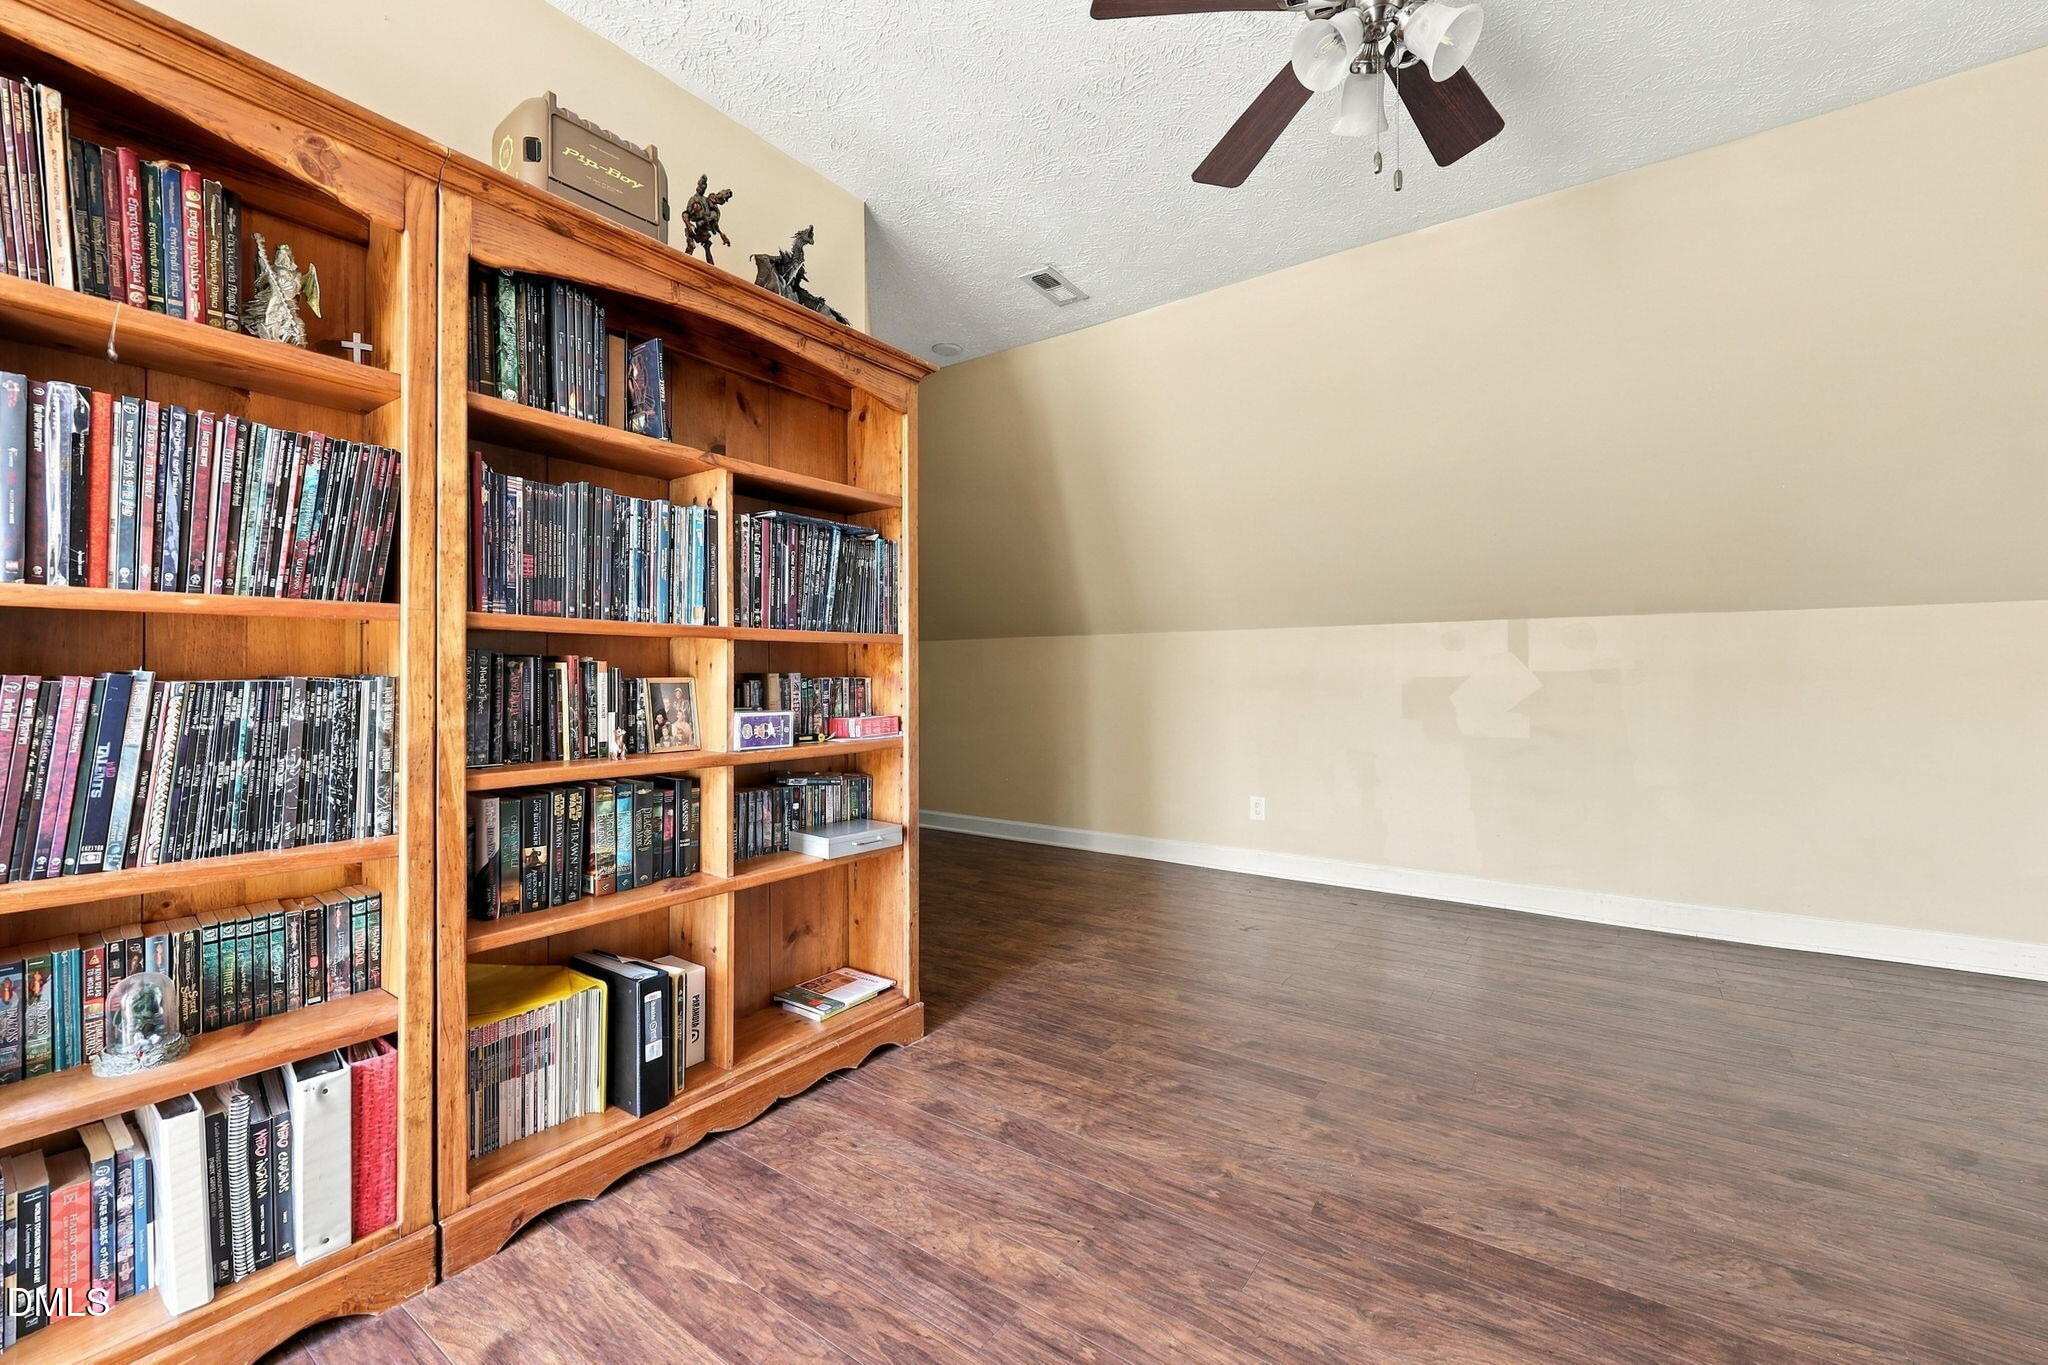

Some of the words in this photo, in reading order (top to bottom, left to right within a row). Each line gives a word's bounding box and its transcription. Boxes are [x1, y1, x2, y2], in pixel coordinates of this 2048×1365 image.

[562, 146, 645, 189] Pip-Boy
[126, 197, 140, 250] Encyclopedia
[148, 222, 159, 266] Encyclopedia
[167, 227, 178, 271] Encyclopedia
[129, 252, 143, 283] Magica
[149, 268, 160, 294] Magica
[169, 272, 180, 297] Magica
[792, 692, 800, 713] FEED
[90, 742, 110, 798] TALENTS
[553, 794, 561, 817] WARS
[568, 792, 576, 821] WARS
[575, 795, 583, 820] STAR
[555, 817, 564, 848] THRAWN
[643, 807, 652, 845] DRAGONS
[570, 821, 580, 865] THRAWN
[87, 968, 94, 976] TO
[188, 990, 198, 1014] Sword
[692, 994, 700, 1028] PARANOIA
[86, 1022, 97, 1056] HARRIS
[255, 1158, 268, 1199] INDIANA
[277, 1152, 289, 1194] CAROLINAS
[70, 1213, 79, 1246] HARRY
[99, 1217, 109, 1245] SHADES
[70, 1249, 78, 1284] POTTER
[98, 1258, 110, 1281] NIGHT
